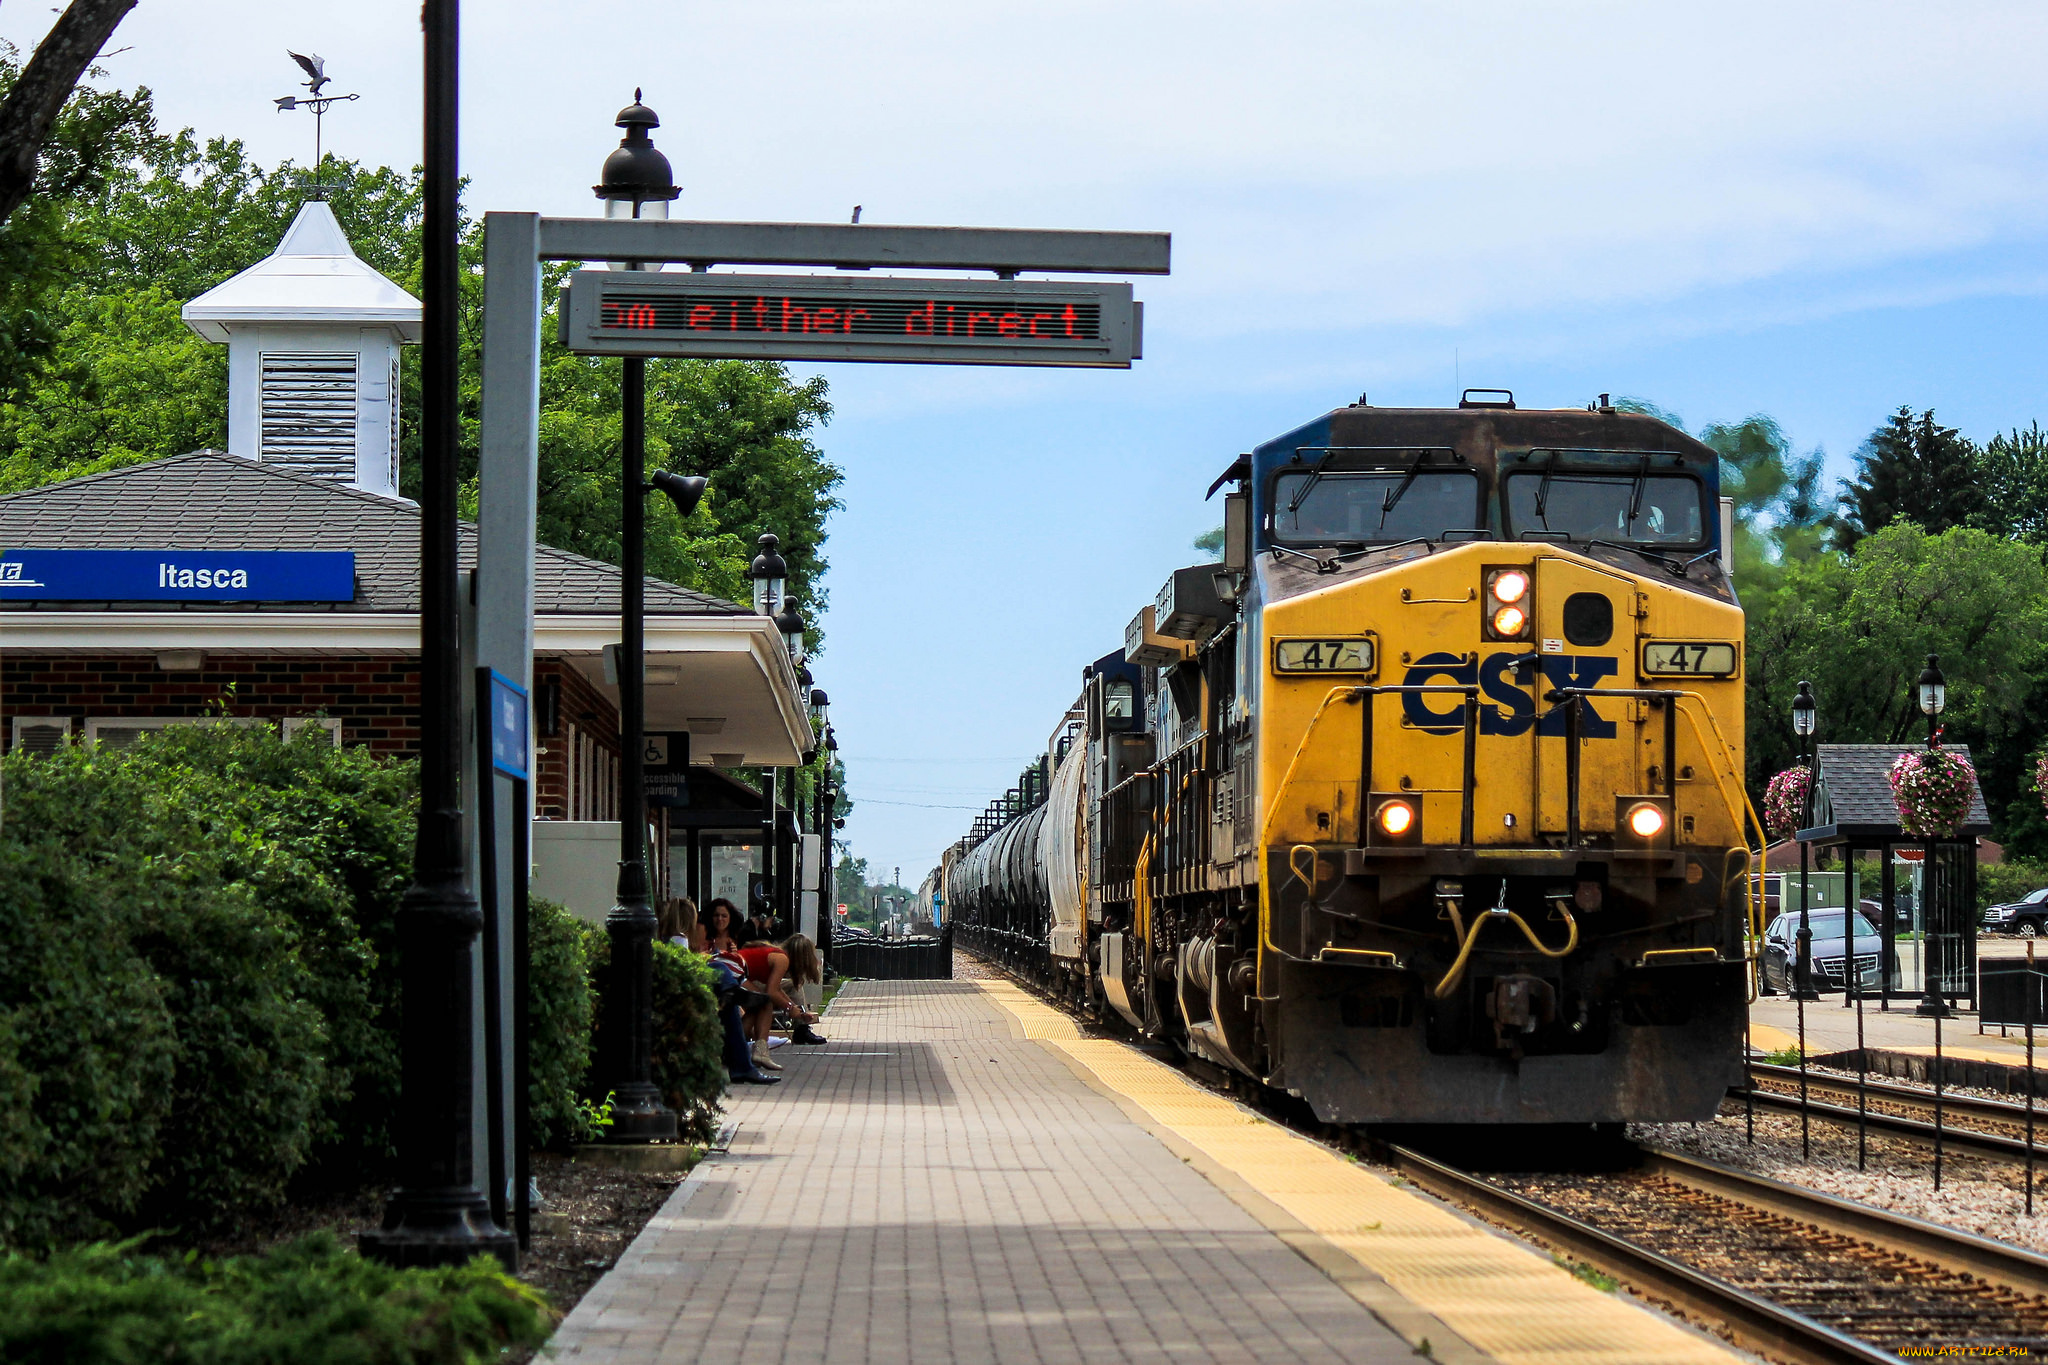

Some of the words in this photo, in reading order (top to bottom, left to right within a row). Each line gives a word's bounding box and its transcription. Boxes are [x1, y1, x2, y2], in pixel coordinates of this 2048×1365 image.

[688, 296, 872, 334] either
[905, 300, 1083, 340] direct
[159, 563, 248, 588] Itasca
[1303, 642, 1344, 669] 47
[1669, 645, 1709, 672] 47
[1401, 652, 1618, 737] CSX
[644, 773, 685, 783] ccessible
[645, 785, 677, 797] oarding
